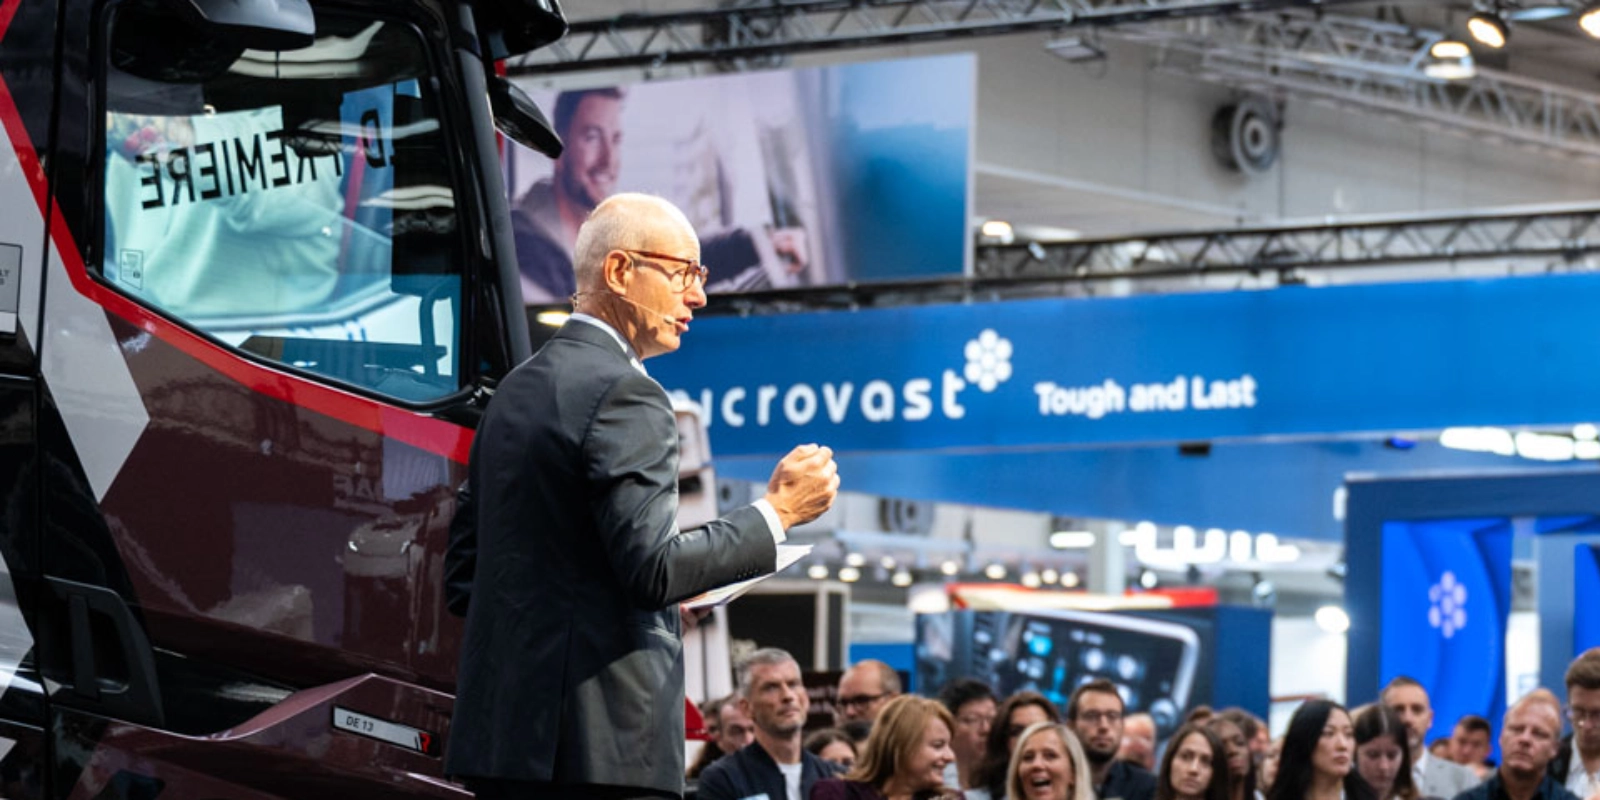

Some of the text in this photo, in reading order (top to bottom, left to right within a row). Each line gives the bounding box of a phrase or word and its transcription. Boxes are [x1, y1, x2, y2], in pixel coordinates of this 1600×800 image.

[1034, 374, 1258, 419] Tough and Last
[346, 716, 374, 732] DE 13
